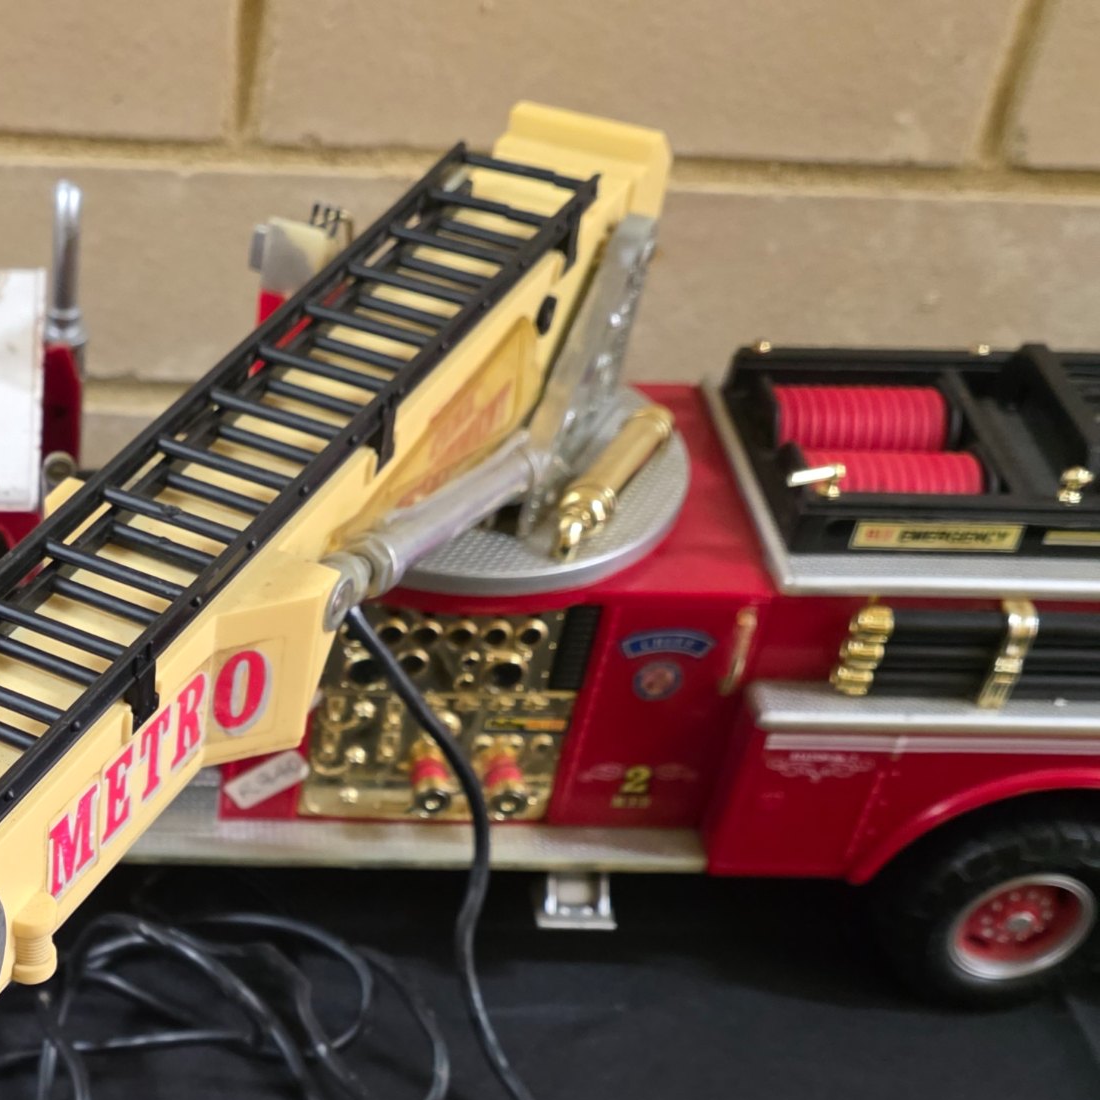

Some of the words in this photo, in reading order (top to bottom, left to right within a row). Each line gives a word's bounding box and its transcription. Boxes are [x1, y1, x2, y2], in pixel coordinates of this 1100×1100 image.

[899, 529, 1009, 543] EMERGENCY
[48, 649, 272, 900] METRO
[620, 765, 652, 793] 2
